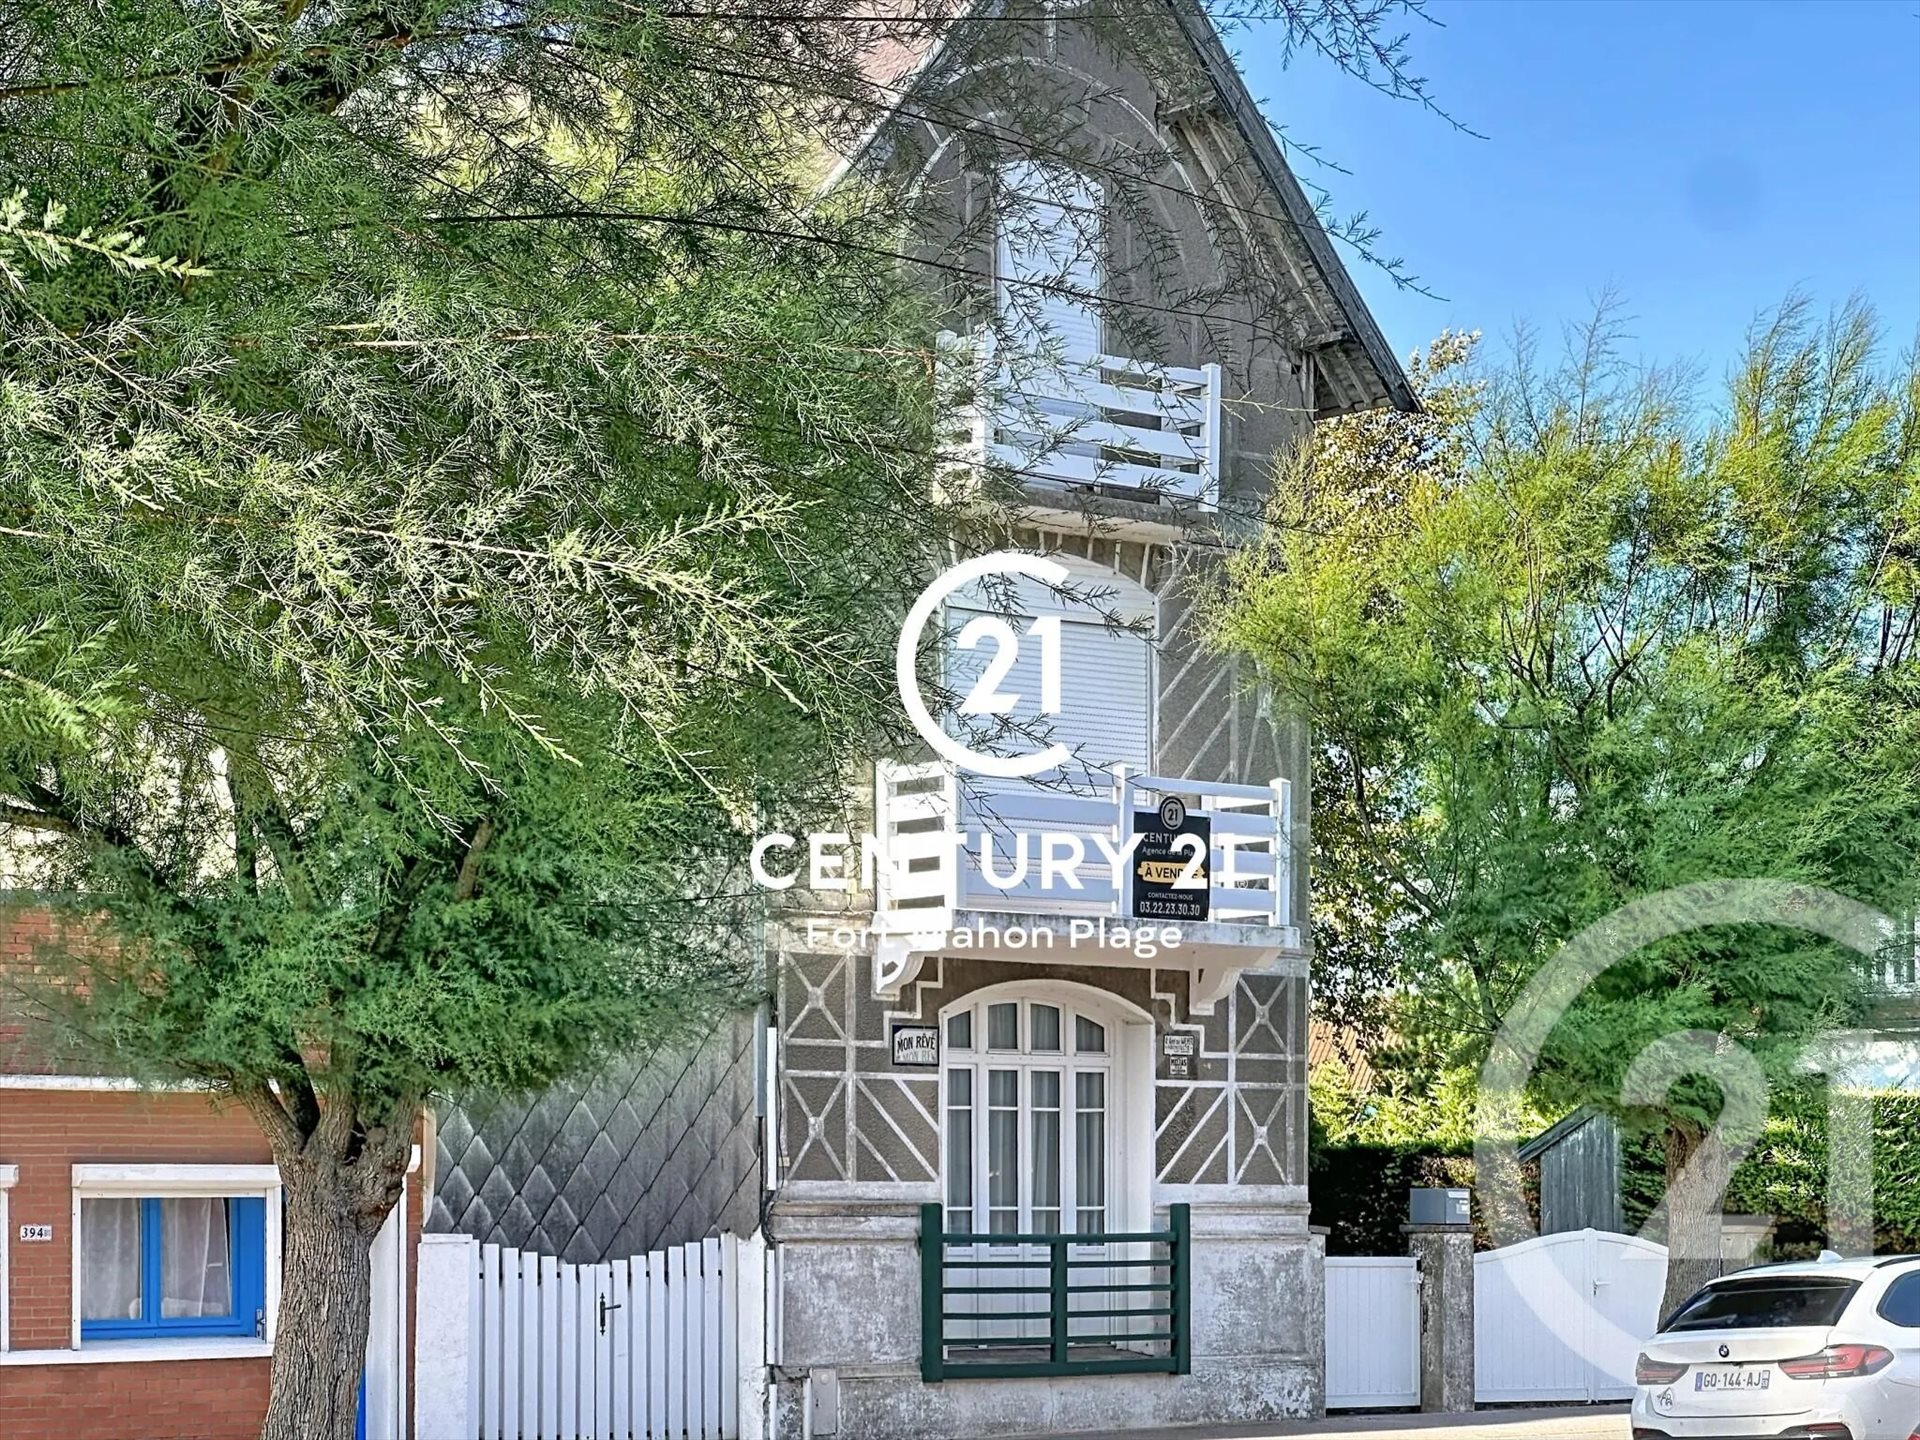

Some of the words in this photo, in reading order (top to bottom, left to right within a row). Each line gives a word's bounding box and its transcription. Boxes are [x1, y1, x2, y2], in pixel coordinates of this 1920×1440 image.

[1140, 901, 1200, 917] 03.22.23.30.30
[897, 1036, 914, 1053] MON
[21, 1227, 43, 1239] 394
